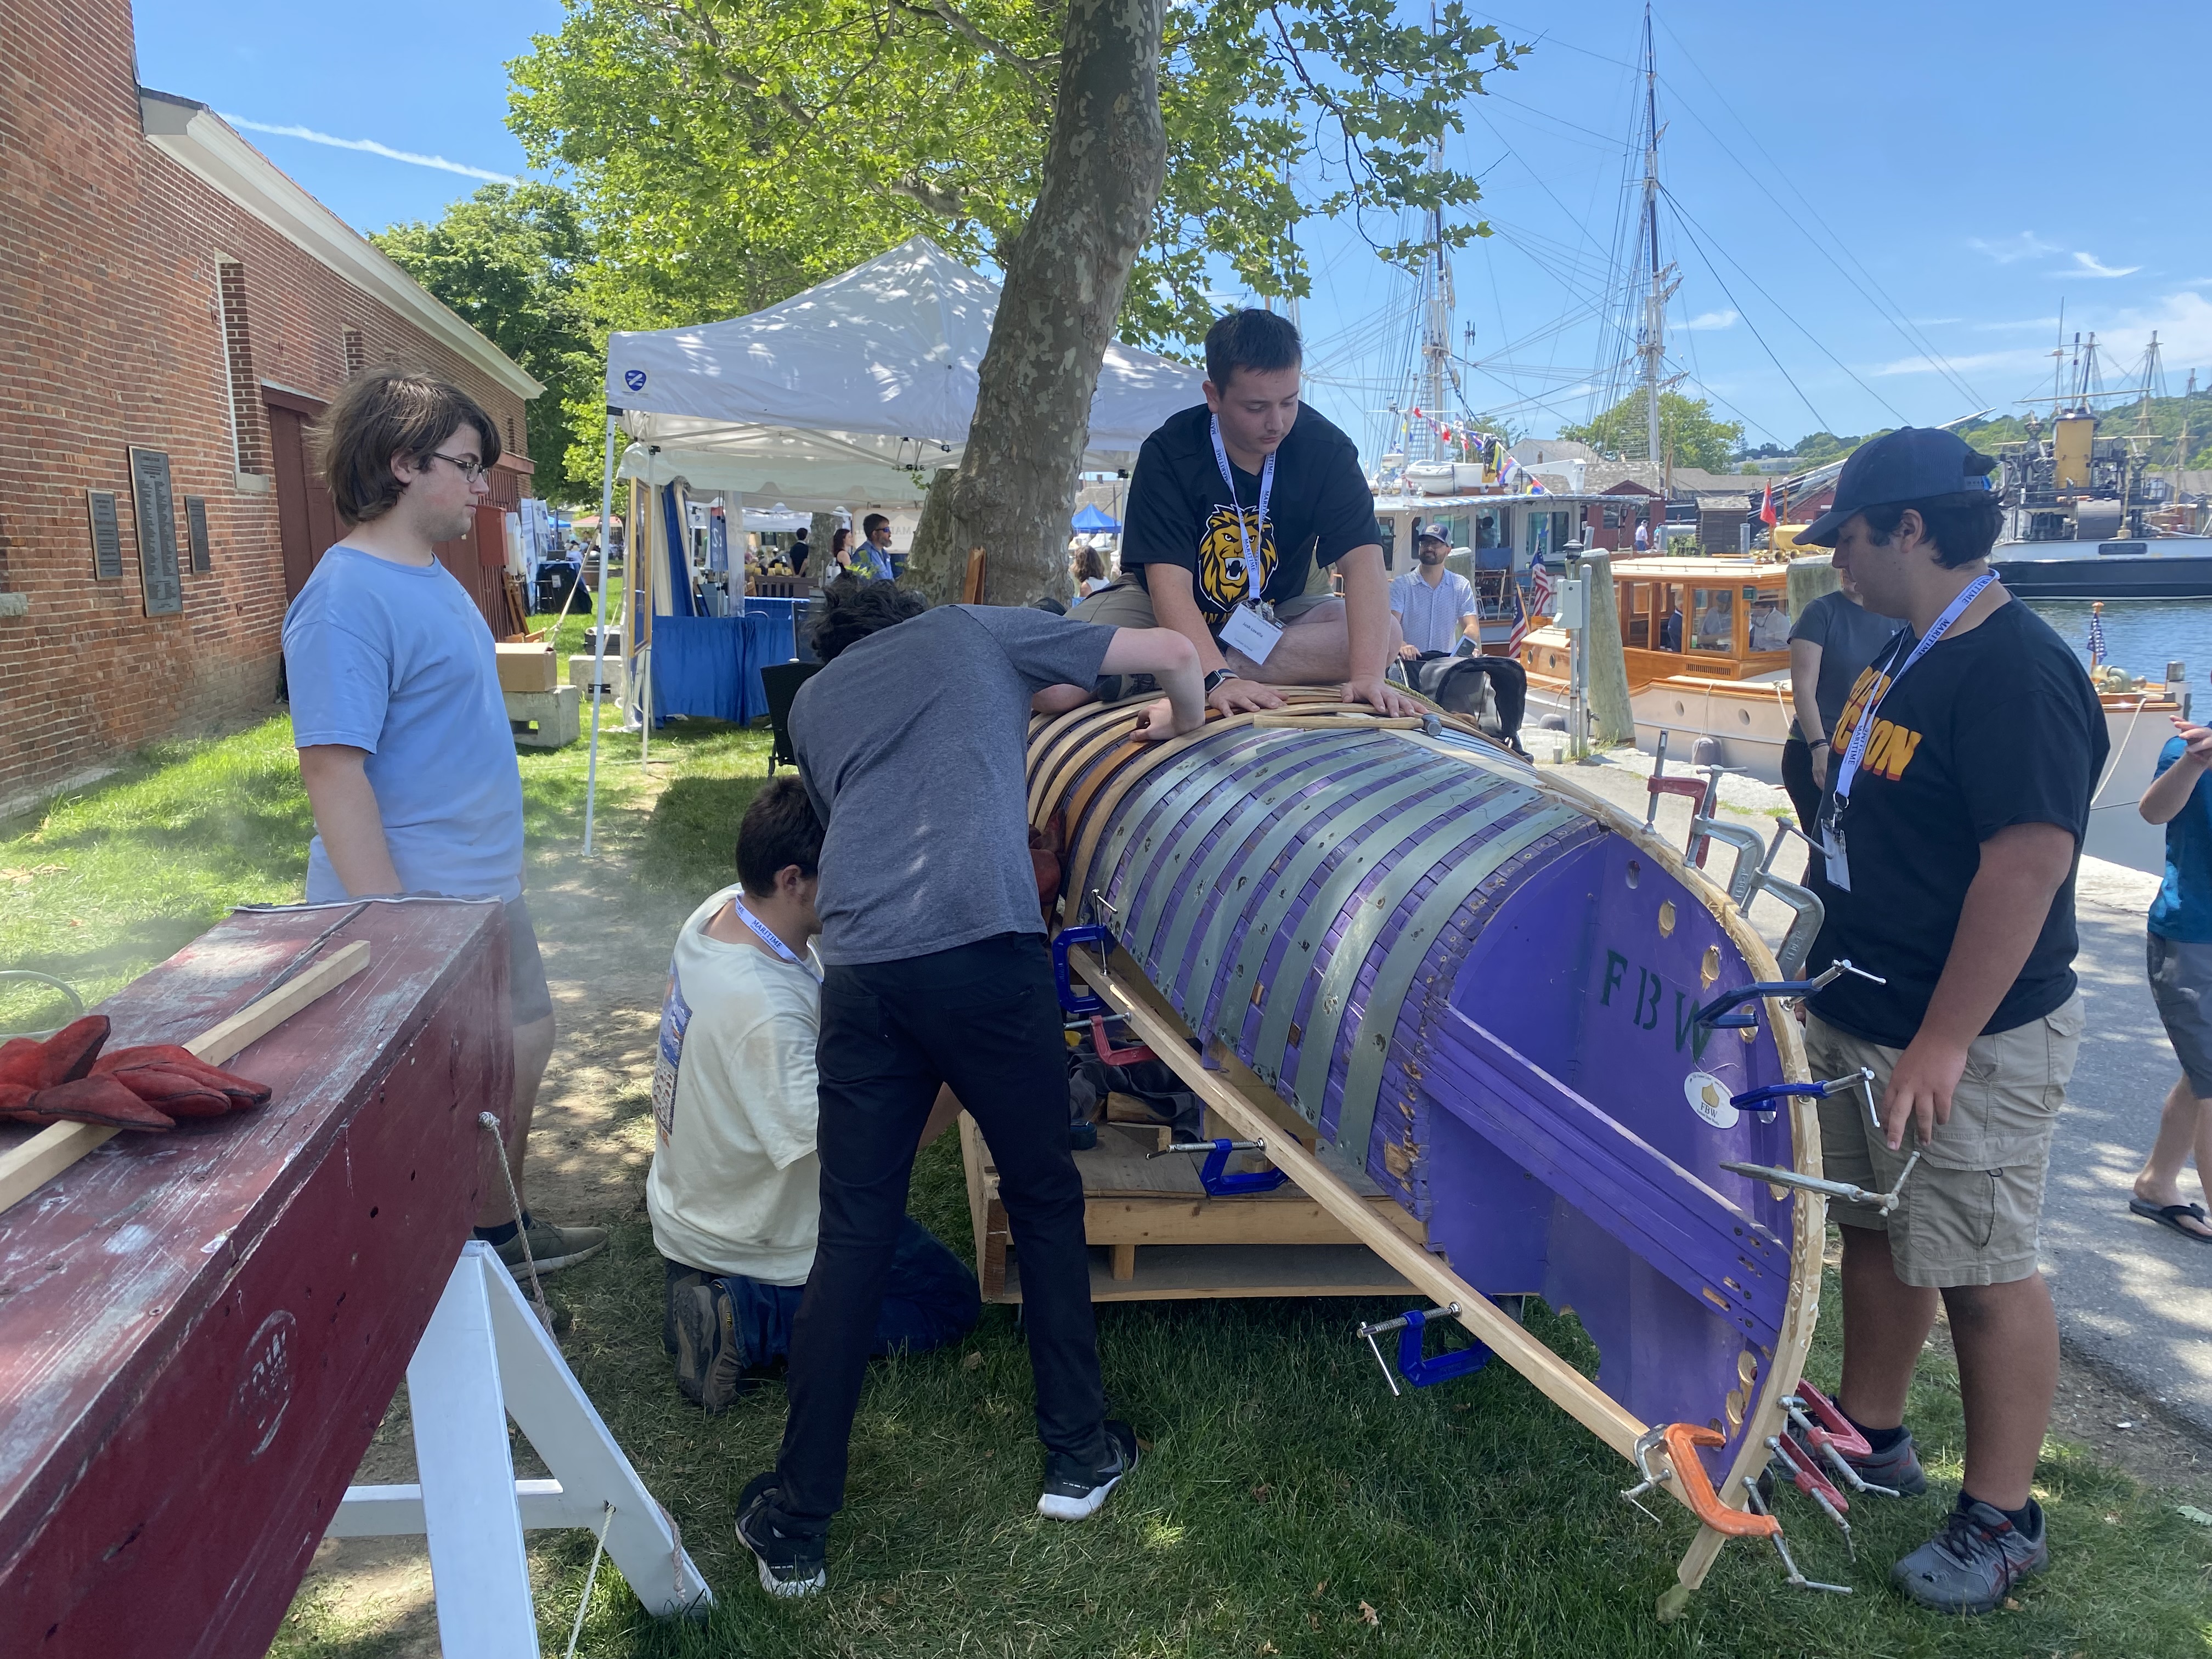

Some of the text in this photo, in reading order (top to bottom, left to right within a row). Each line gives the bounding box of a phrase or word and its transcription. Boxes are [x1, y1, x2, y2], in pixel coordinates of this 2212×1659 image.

[1216, 448, 1229, 481] MARITIME
[1244, 538, 1256, 572] MARITIME
[1916, 618, 1950, 657] MARITIME
[1848, 725, 1863, 765] MARITIME
[752, 919, 782, 949] MARITIME
[1600, 949, 1712, 1063] FBW
[1700, 1102, 1718, 1118] FBW
